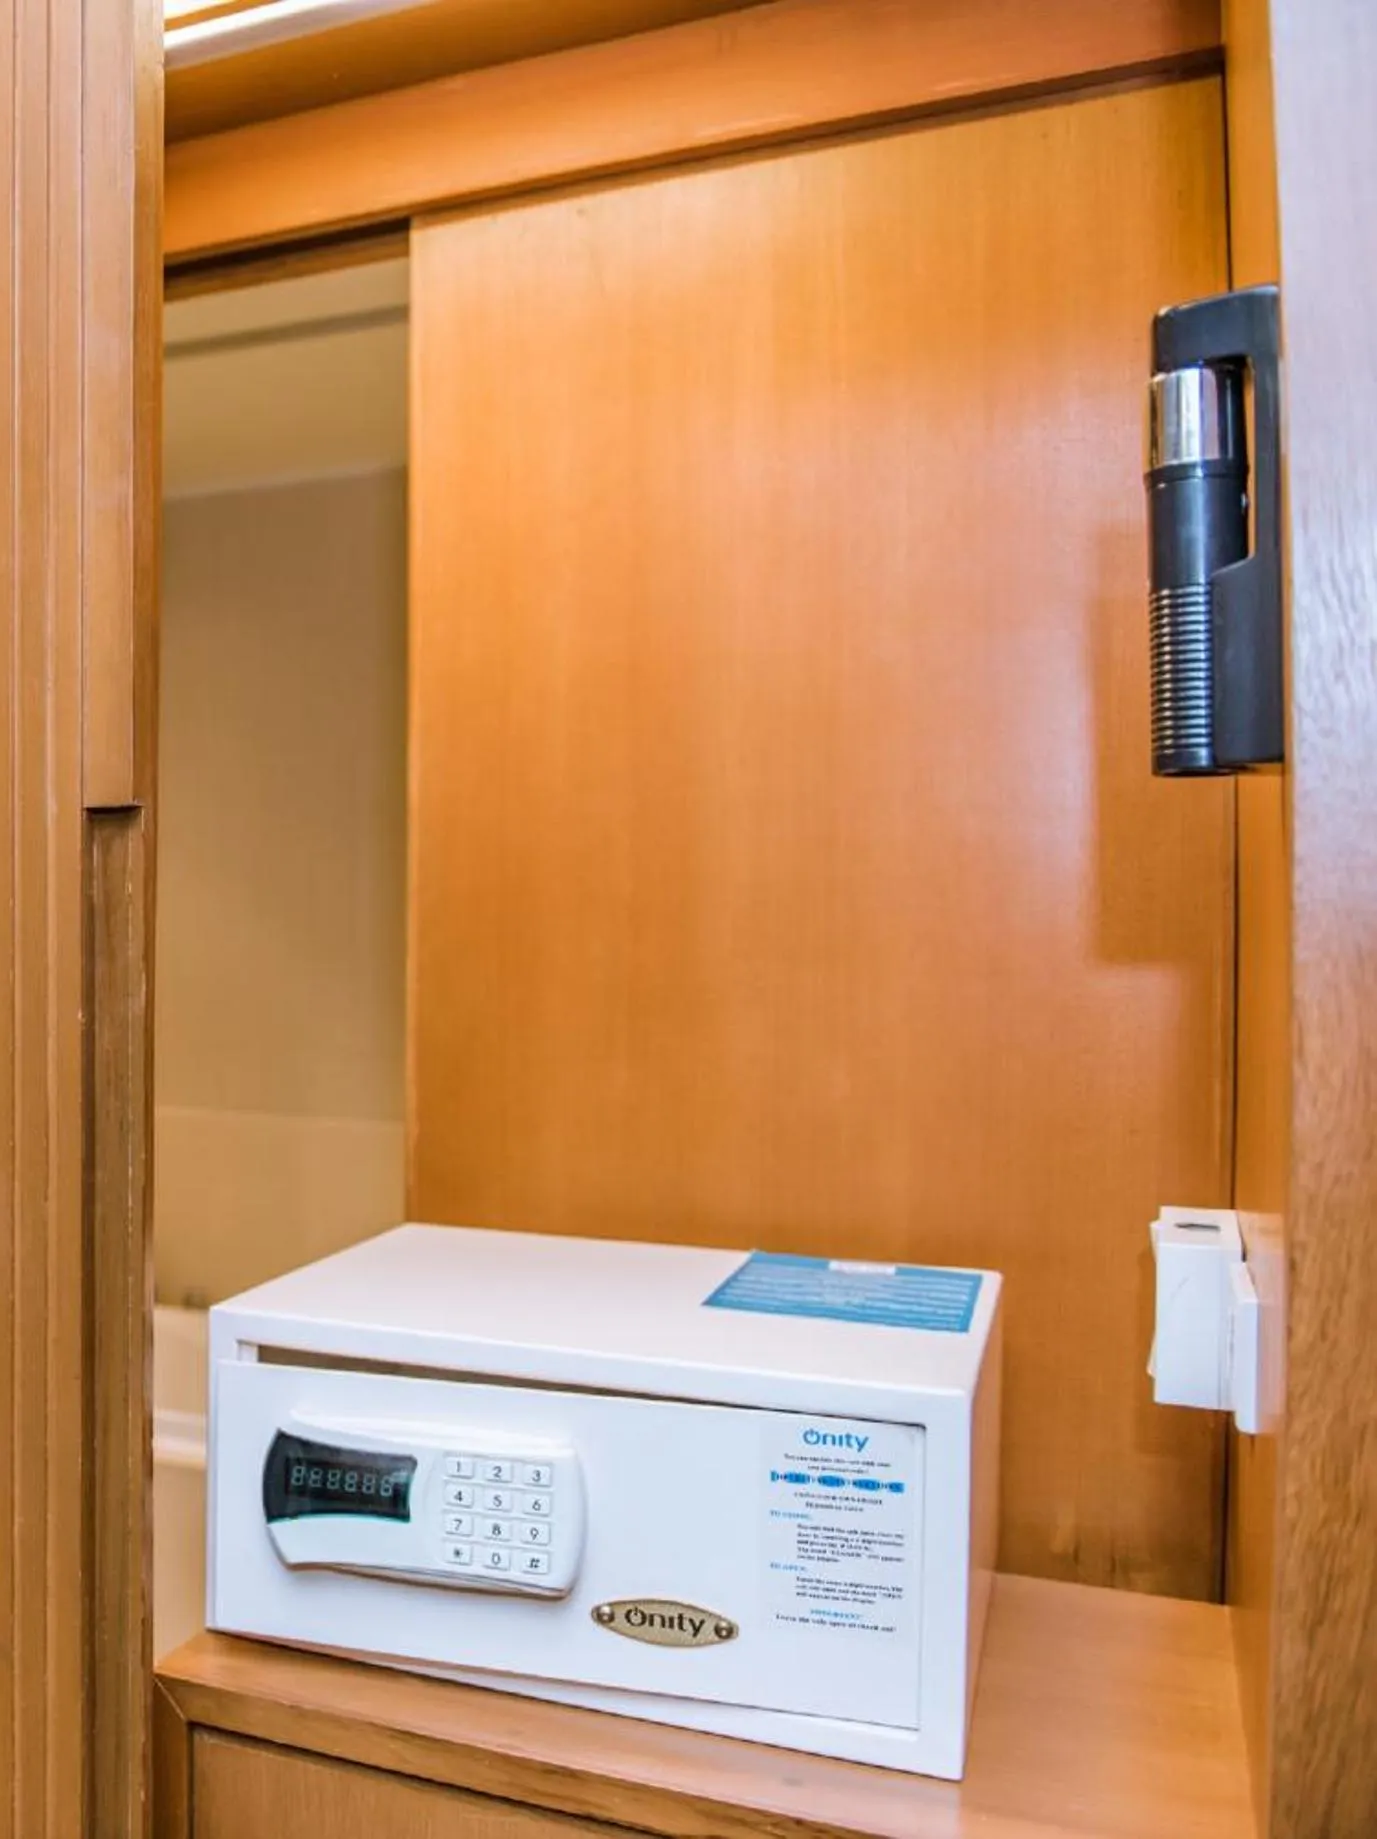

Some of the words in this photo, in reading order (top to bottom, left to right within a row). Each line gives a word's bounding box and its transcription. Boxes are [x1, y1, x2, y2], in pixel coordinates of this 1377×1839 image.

[803, 1428, 870, 1453] Onity
[492, 1465, 503, 1479] 2
[531, 1469, 542, 1482] 3
[453, 1490, 464, 1502] 4
[492, 1494, 503, 1508] 5
[531, 1499, 542, 1512] 6
[452, 1518, 463, 1531] 7
[491, 1522, 502, 1536] 8
[530, 1527, 540, 1541] 9
[491, 1551, 502, 1565] 0
[624, 1606, 706, 1639] Onity
